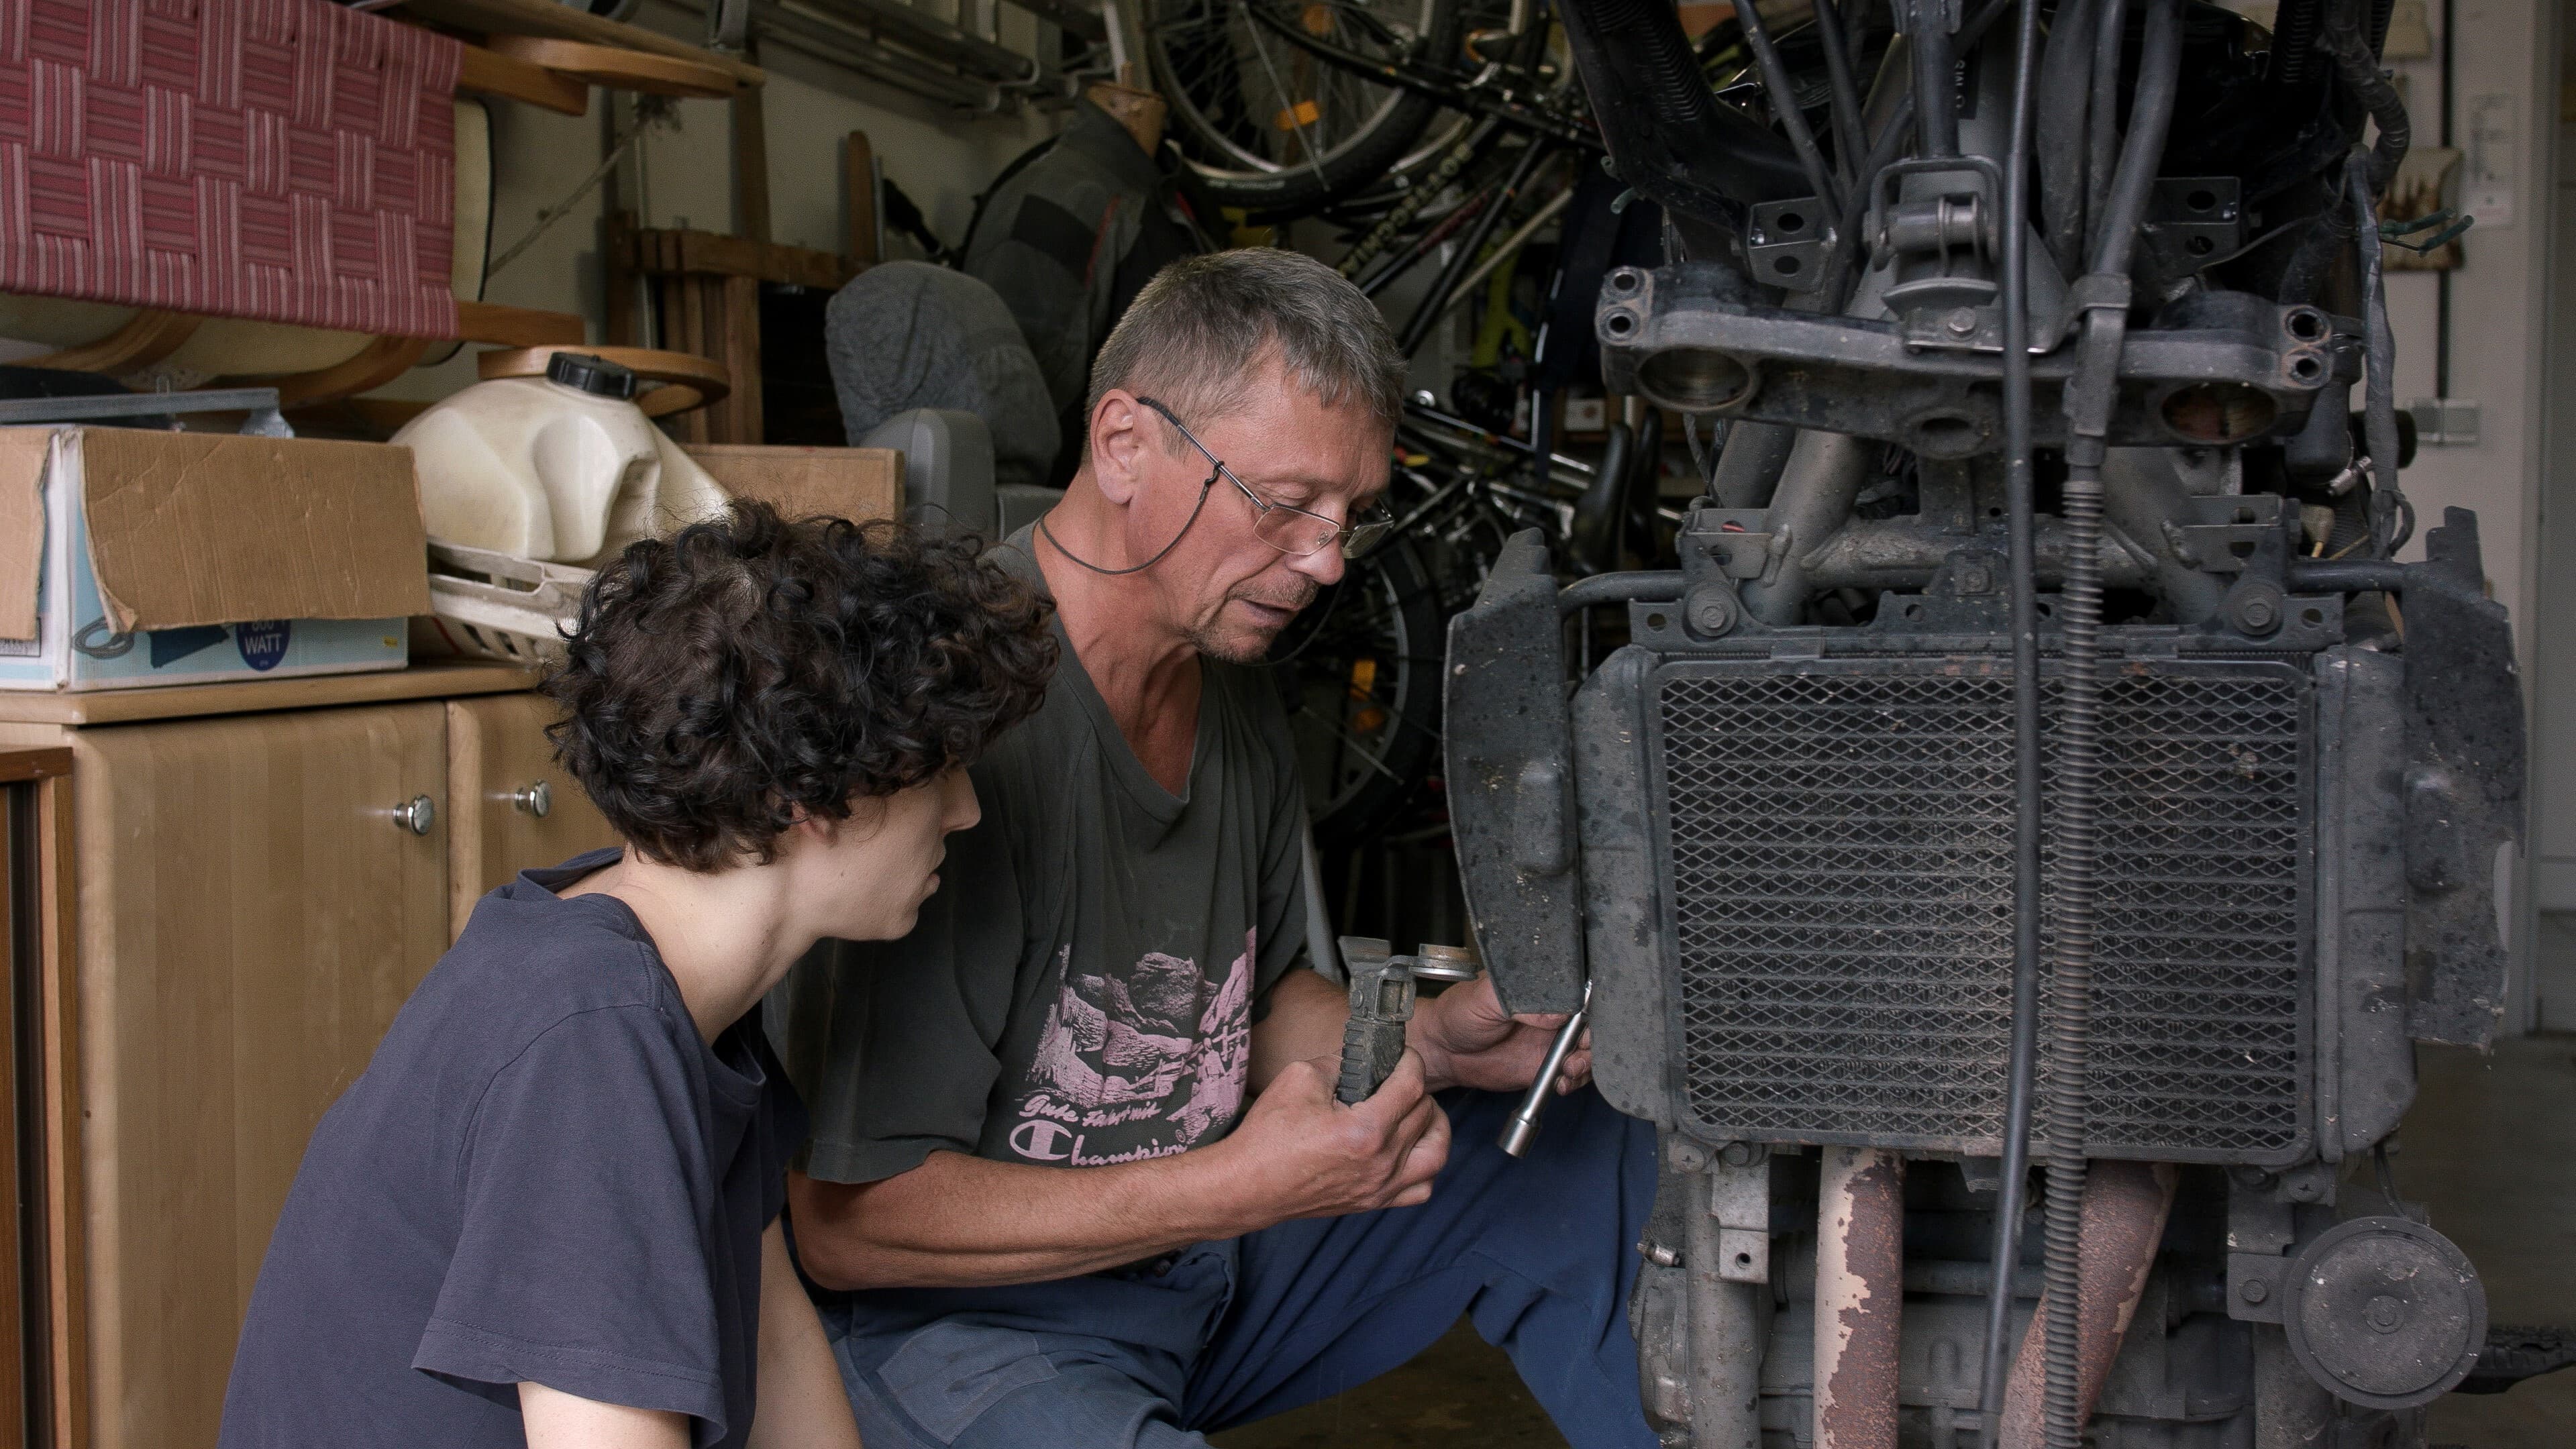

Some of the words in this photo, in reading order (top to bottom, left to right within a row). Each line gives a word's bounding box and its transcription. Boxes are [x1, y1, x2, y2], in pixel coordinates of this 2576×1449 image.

[245, 633, 281, 655] WATT
[1019, 1094, 1079, 1122] Gute
[1009, 1119, 1187, 1165] Champion
